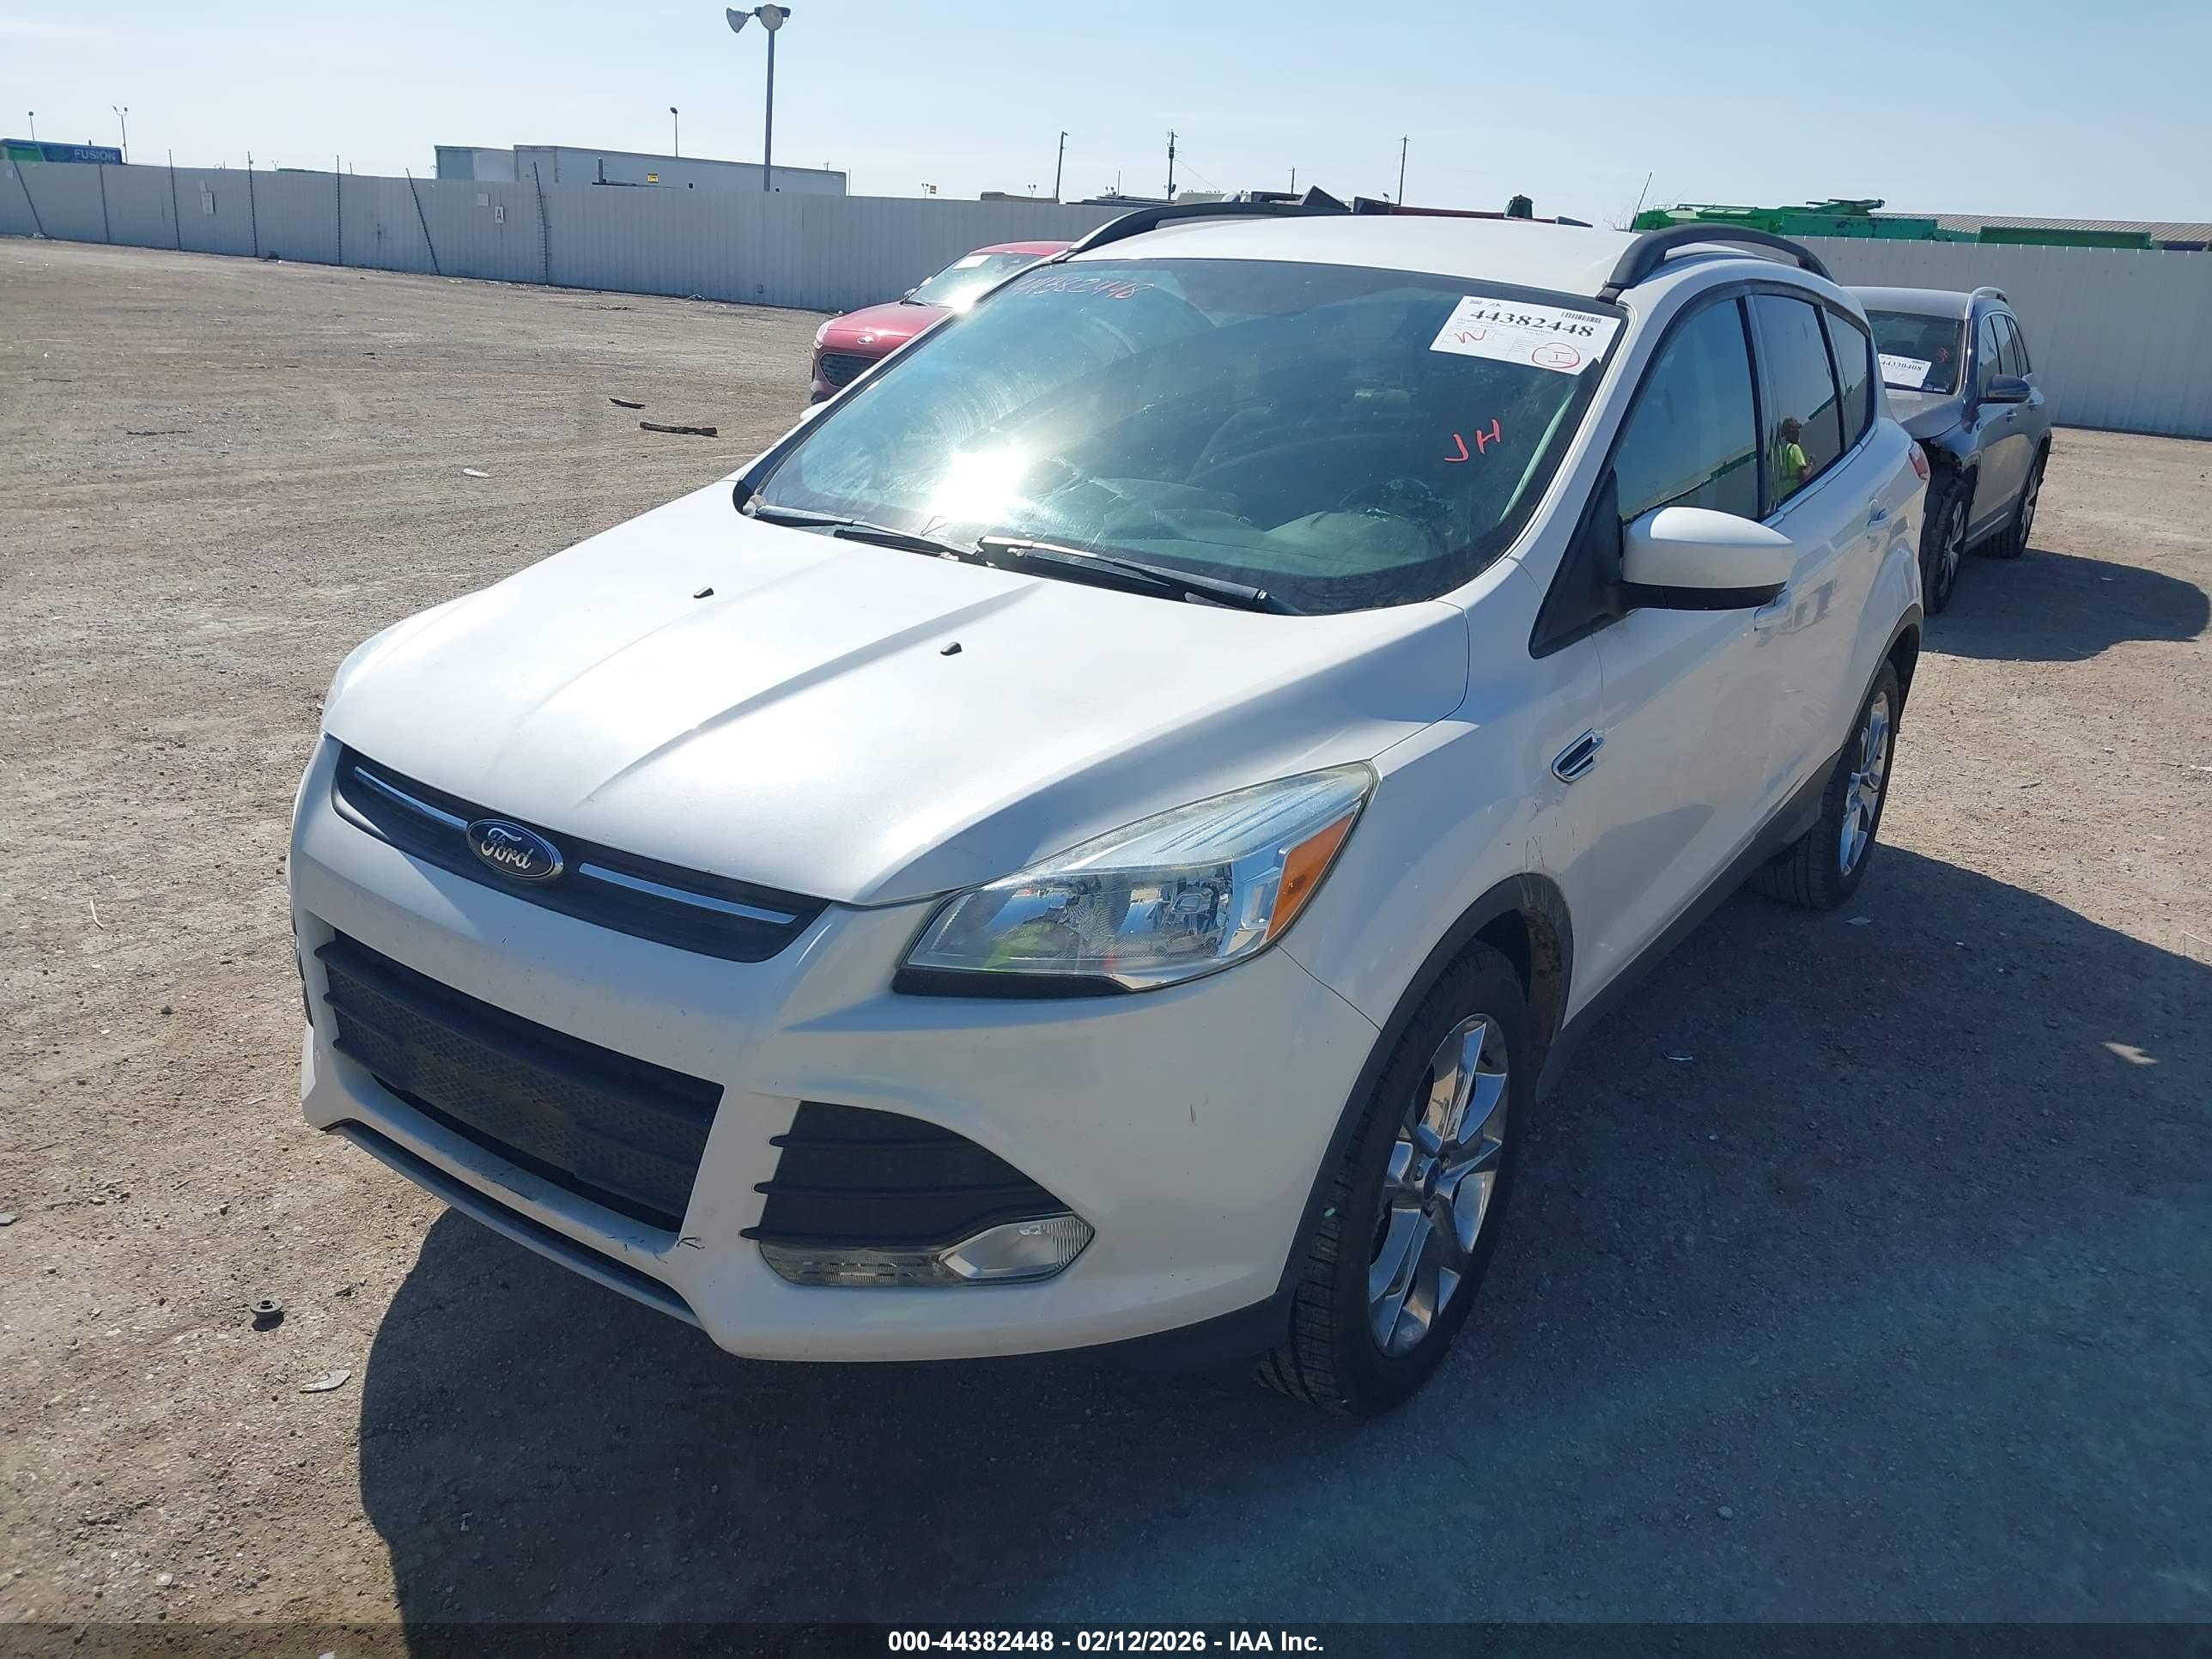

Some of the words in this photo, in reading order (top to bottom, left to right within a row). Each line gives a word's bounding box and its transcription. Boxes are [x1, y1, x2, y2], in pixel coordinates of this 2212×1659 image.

[74, 149, 116, 161] FUSION
[1470, 309, 1595, 337] 44382448
[480, 827, 535, 870] Ford
